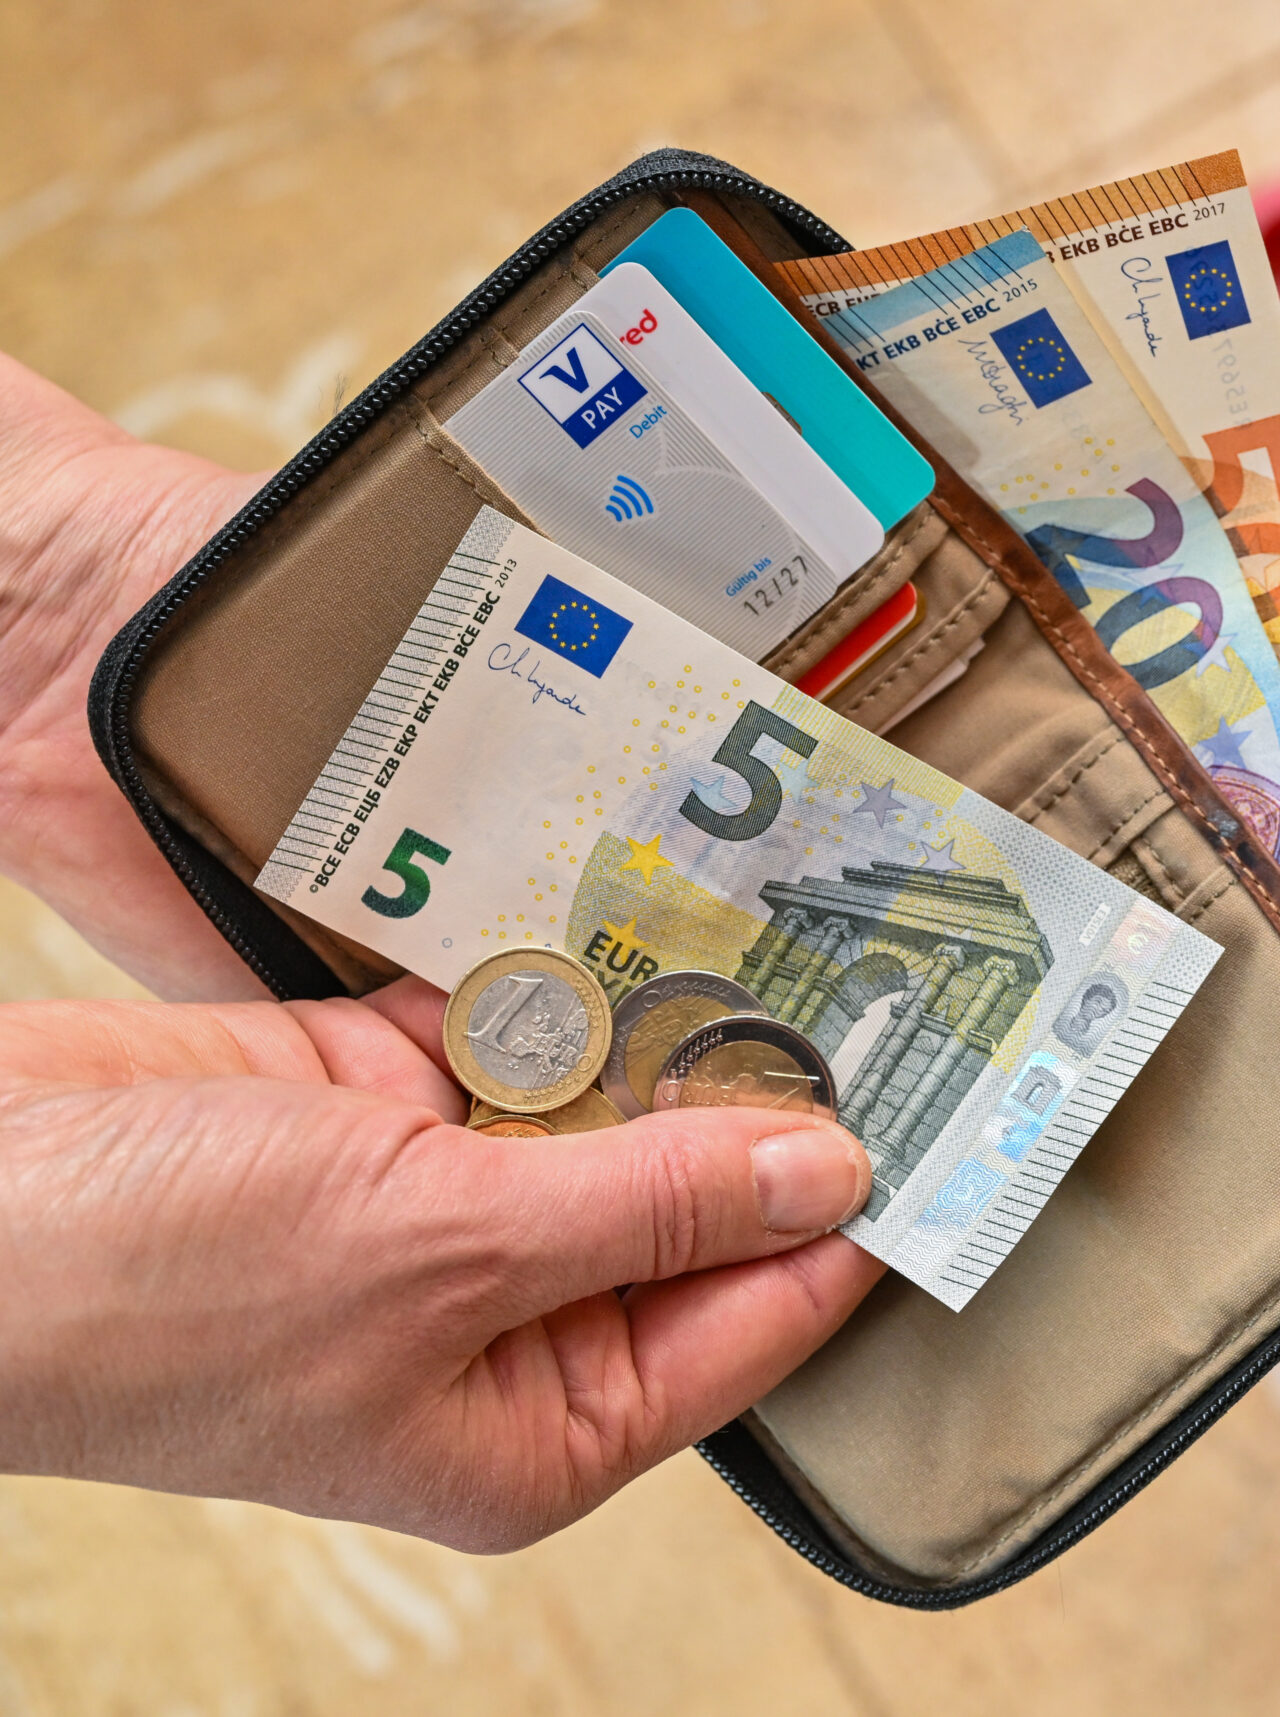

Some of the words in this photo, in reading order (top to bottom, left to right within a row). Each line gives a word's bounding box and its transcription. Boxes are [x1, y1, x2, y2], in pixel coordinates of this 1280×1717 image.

[1059, 238, 1100, 261] EKB
[1149, 213, 1189, 236] EBC
[1192, 202, 1226, 221] 2017
[856, 350, 882, 371] KT
[883, 334, 921, 360] EKB
[962, 298, 1001, 325] EBC
[1003, 278, 1039, 302] 2015
[539, 347, 590, 393] V
[581, 387, 624, 429] PAY
[629, 404, 667, 439] Debit
[726, 570, 758, 597] Gültig
[753, 556, 772, 575] bis
[744, 555, 809, 616] 12/27
[1024, 477, 1223, 691] 20
[334, 822, 361, 856] ECB
[374, 757, 400, 789] EZB
[393, 724, 418, 757] EKP
[413, 691, 440, 724] EKT
[432, 658, 460, 692] EKB
[472, 591, 501, 625] EBC
[494, 558, 518, 588] 2013
[679, 700, 819, 841] 5
[361, 827, 452, 919] 5
[583, 929, 659, 983] EUR
[463, 975, 544, 1054] 1
